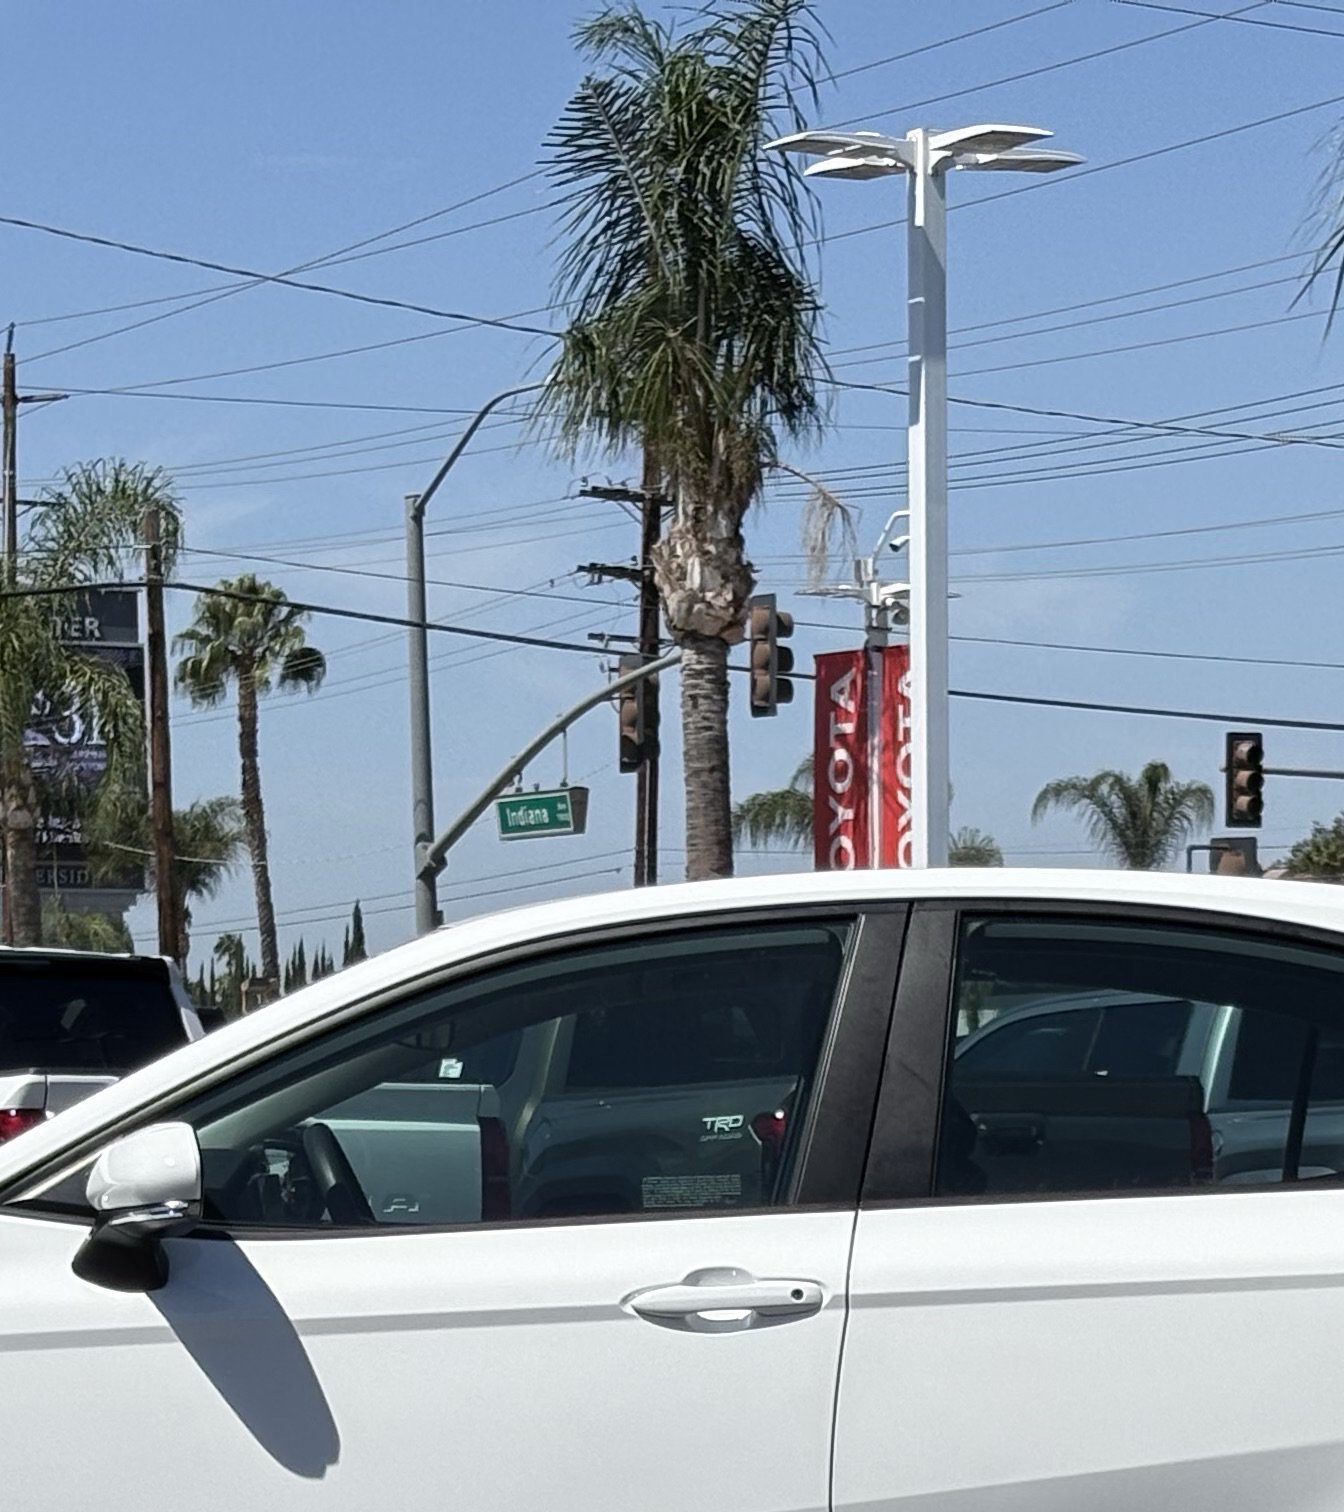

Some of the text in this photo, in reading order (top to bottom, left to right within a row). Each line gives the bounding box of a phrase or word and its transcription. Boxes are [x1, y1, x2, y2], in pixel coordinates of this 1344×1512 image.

[506, 806, 550, 828] Indiana
[828, 667, 856, 871] OYOTA
[896, 669, 913, 870] OYOTA
[702, 1115, 744, 1133] TRD
